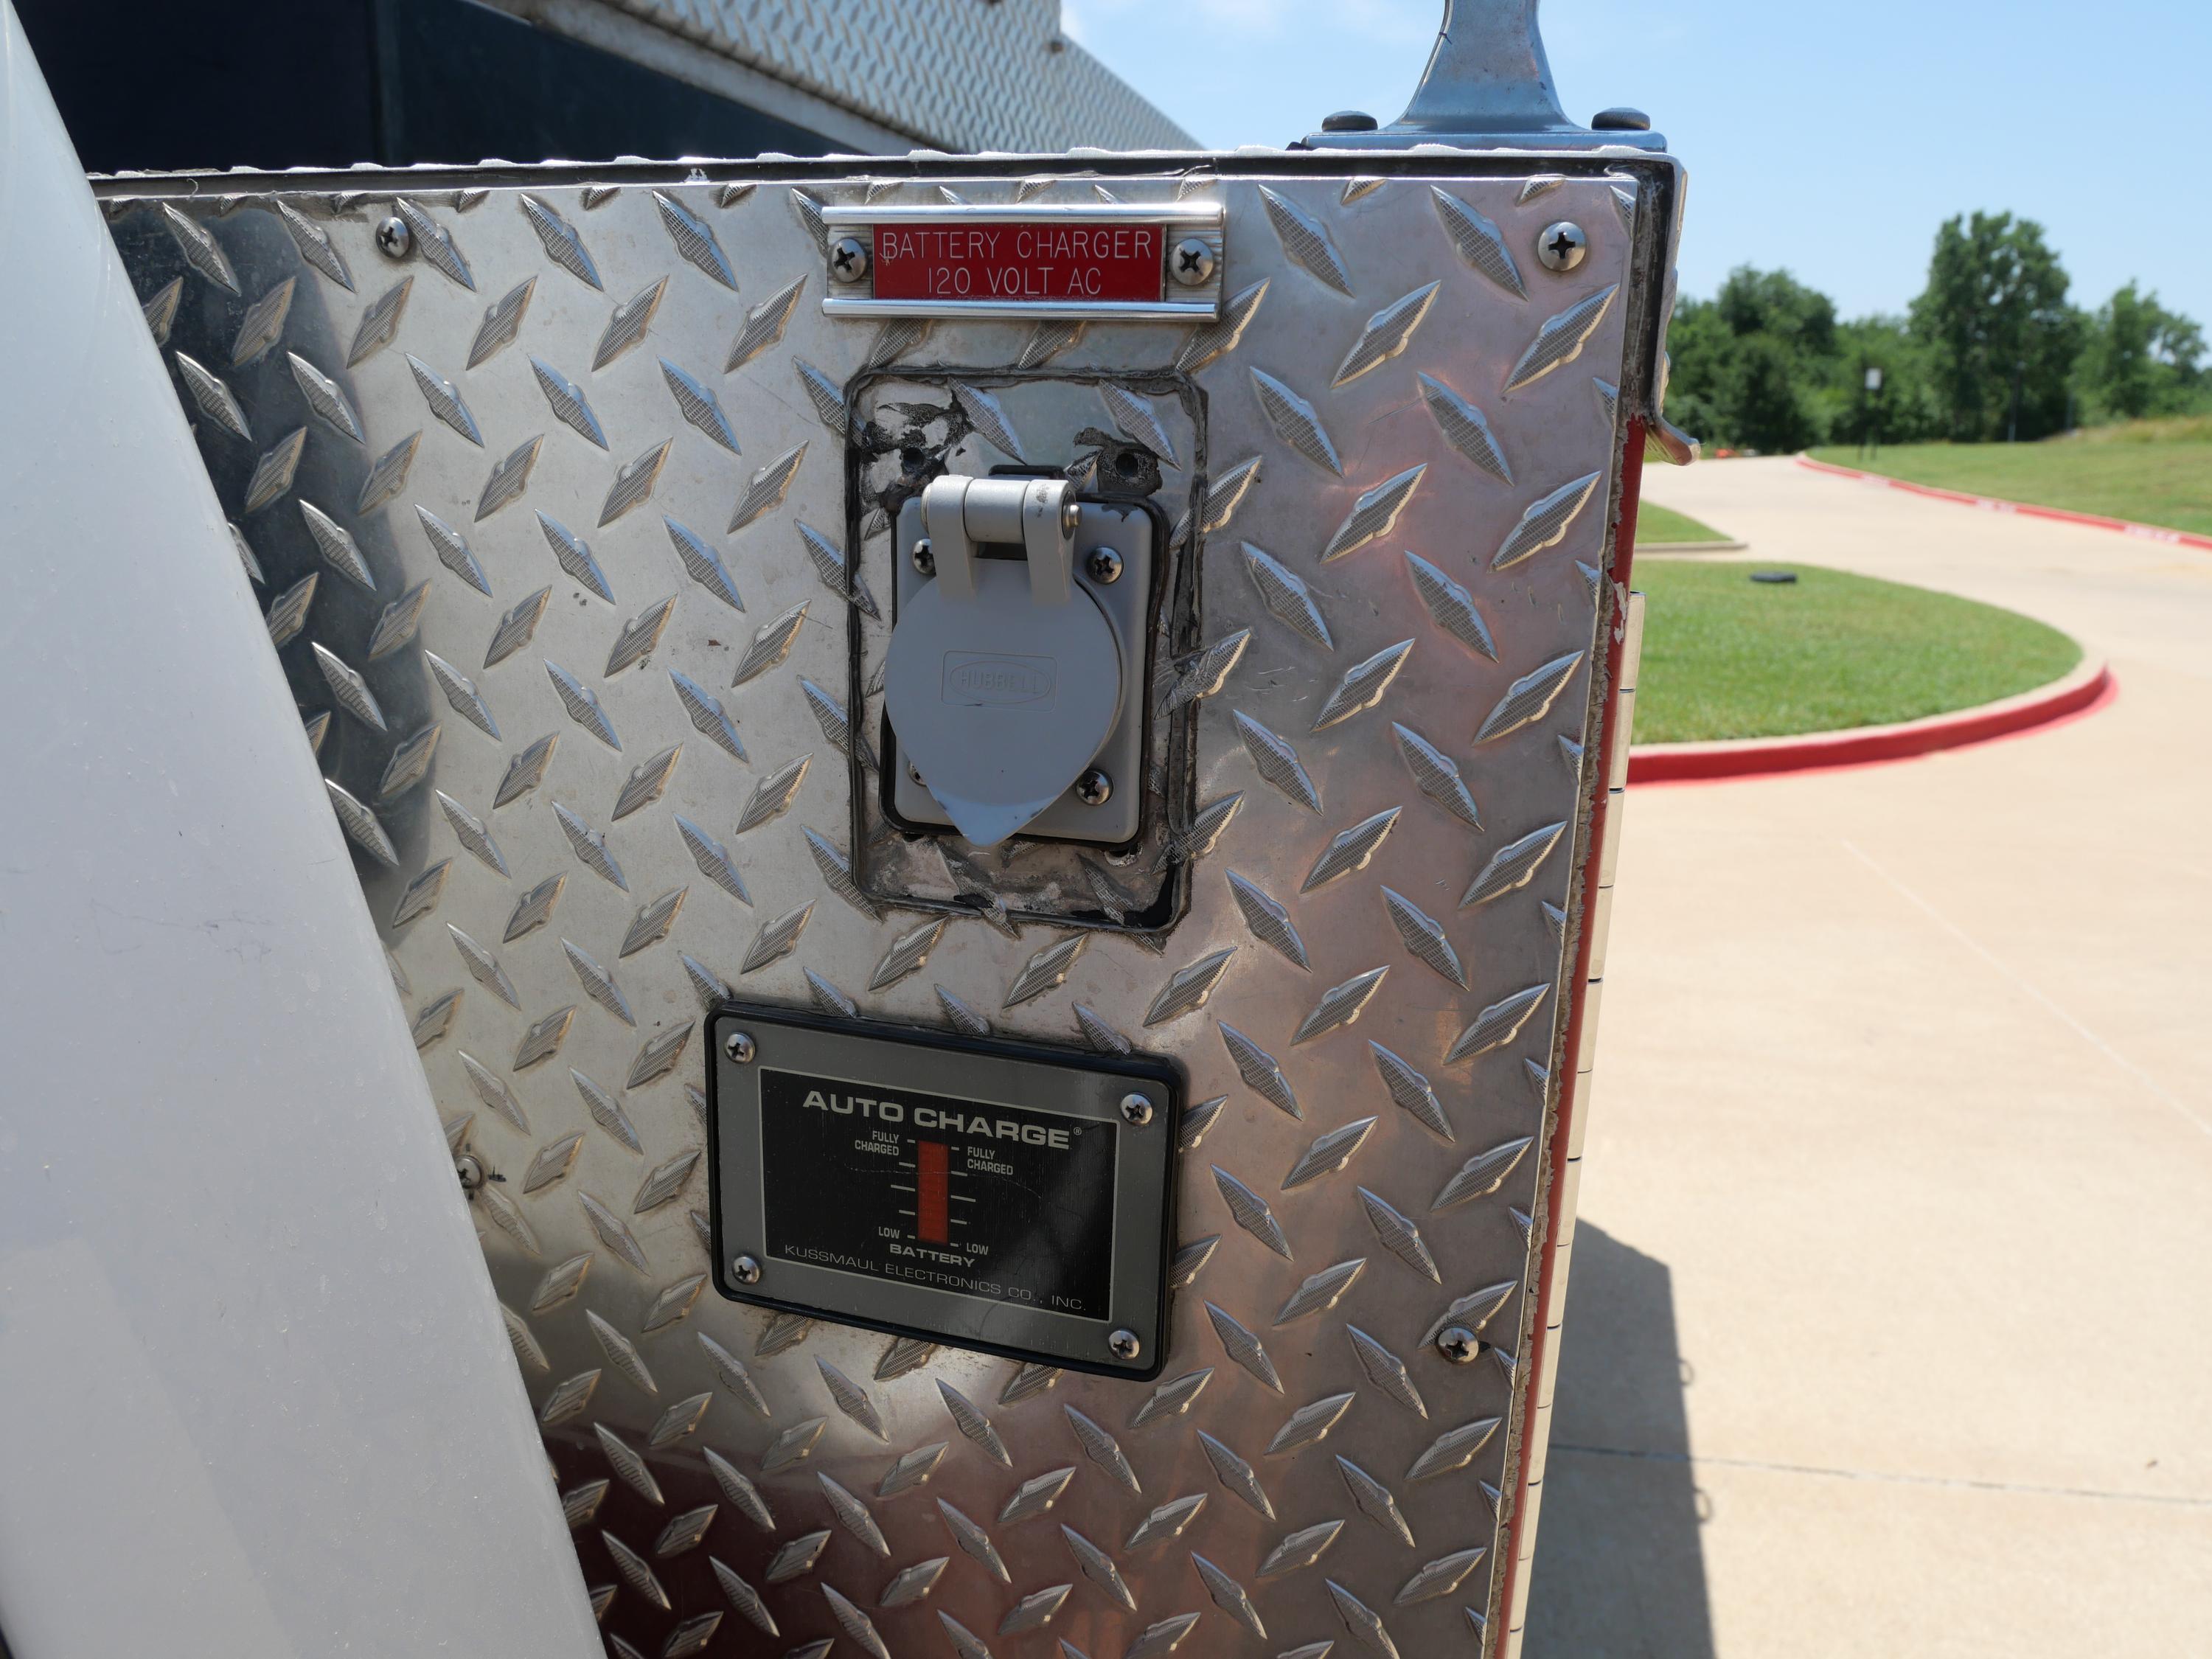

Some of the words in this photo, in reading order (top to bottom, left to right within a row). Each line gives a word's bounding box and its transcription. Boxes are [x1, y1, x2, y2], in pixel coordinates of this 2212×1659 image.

[882, 231, 1001, 259] BATTERY
[1017, 230, 1152, 260] CHARGER
[928, 267, 970, 295] 120
[987, 267, 1054, 295] VOLT
[1068, 267, 1102, 295] AC
[802, 1091, 904, 1123] AUTO
[872, 1130, 900, 1144] FULLY
[855, 1139, 900, 1156] CHARGED
[967, 1146, 995, 1160] FULLY
[967, 1159, 1014, 1176] CHARGED
[878, 1226, 900, 1239] LOW
[889, 1243, 976, 1267] BATTERY
[966, 1242, 990, 1256] LOW
[785, 1244, 880, 1272] KUSSMAUL
[885, 1262, 1001, 1295] ELECTRONICS
